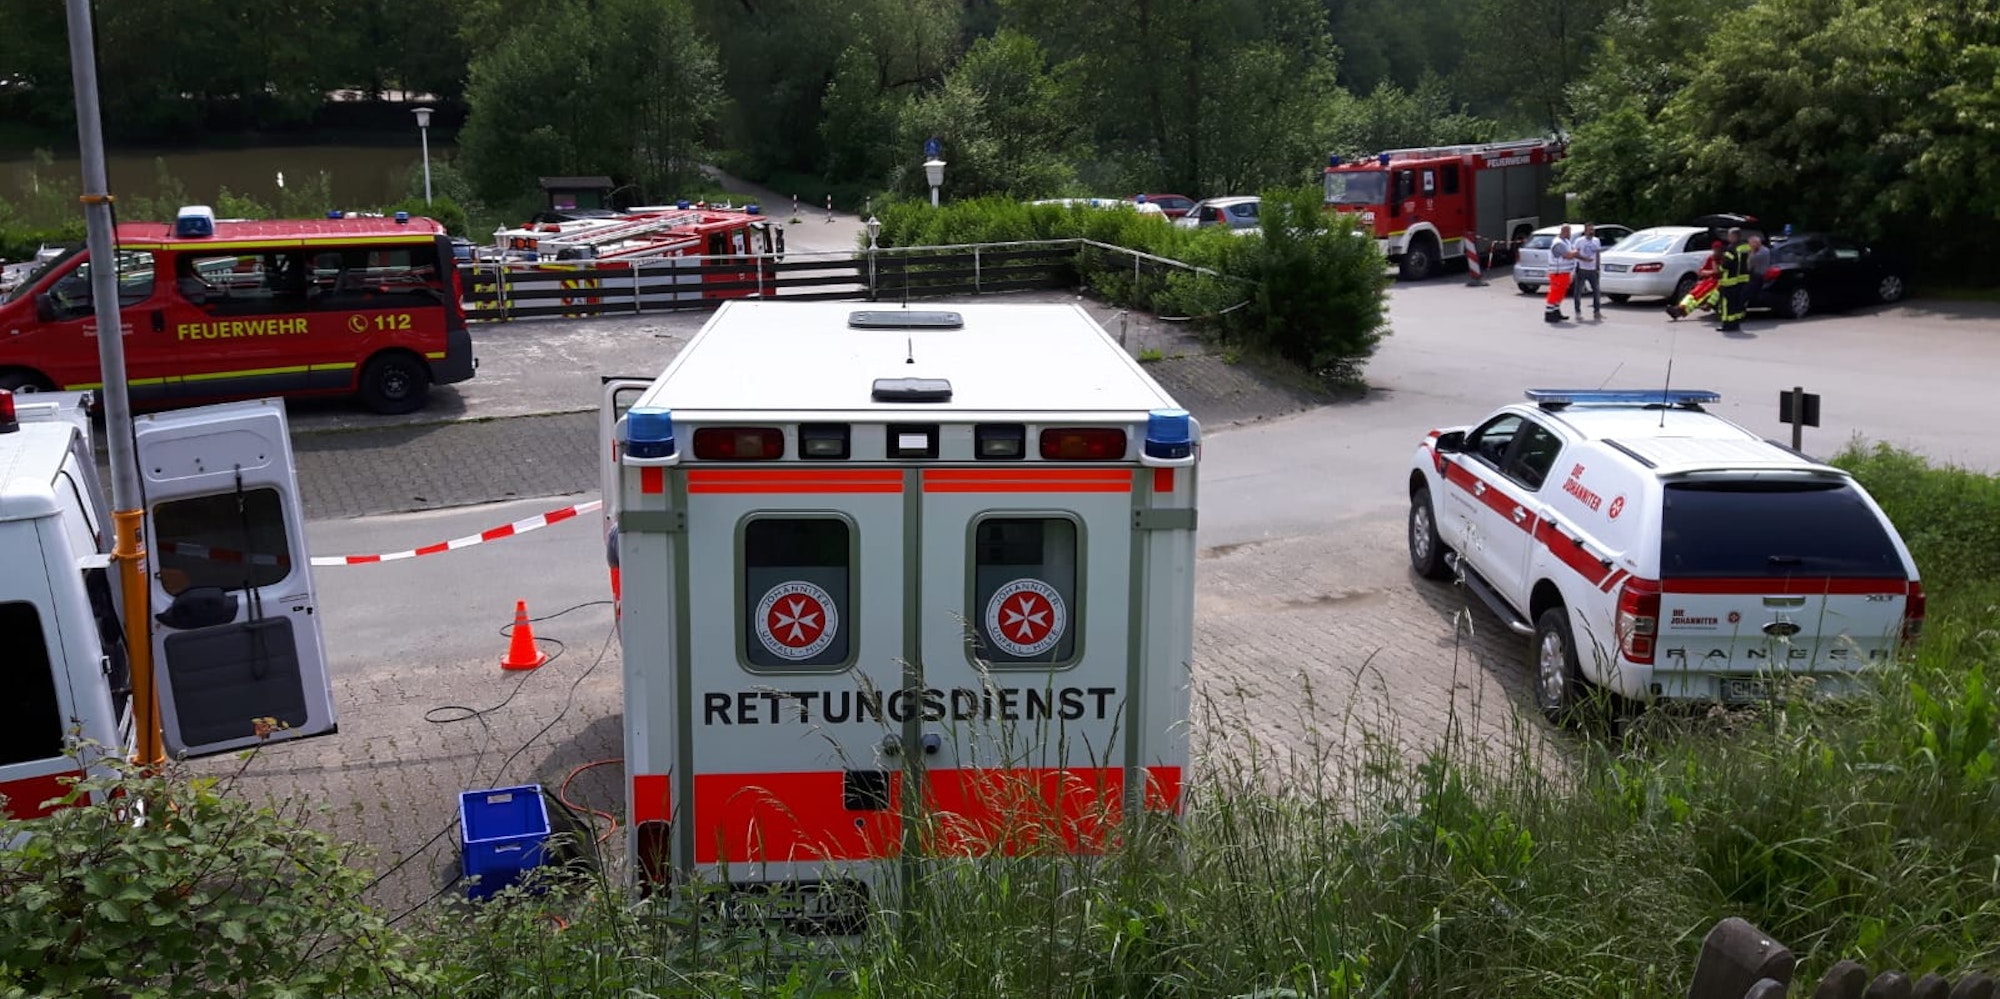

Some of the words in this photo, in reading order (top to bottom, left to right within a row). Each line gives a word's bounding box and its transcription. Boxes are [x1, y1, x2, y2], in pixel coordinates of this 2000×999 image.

[1487, 155, 1531, 168] FEUERWEHR
[177, 318, 308, 340] FEUERWEHR
[374, 314, 411, 330] 112
[1571, 463, 1585, 479] DIE
[1563, 477, 1602, 512] JOHANNITER
[765, 585, 830, 608] JOHANNITER
[996, 583, 1060, 606] JOHANNITER
[1666, 648, 1889, 660] RANGER
[703, 687, 1116, 726] RETTUNGSDIENST
